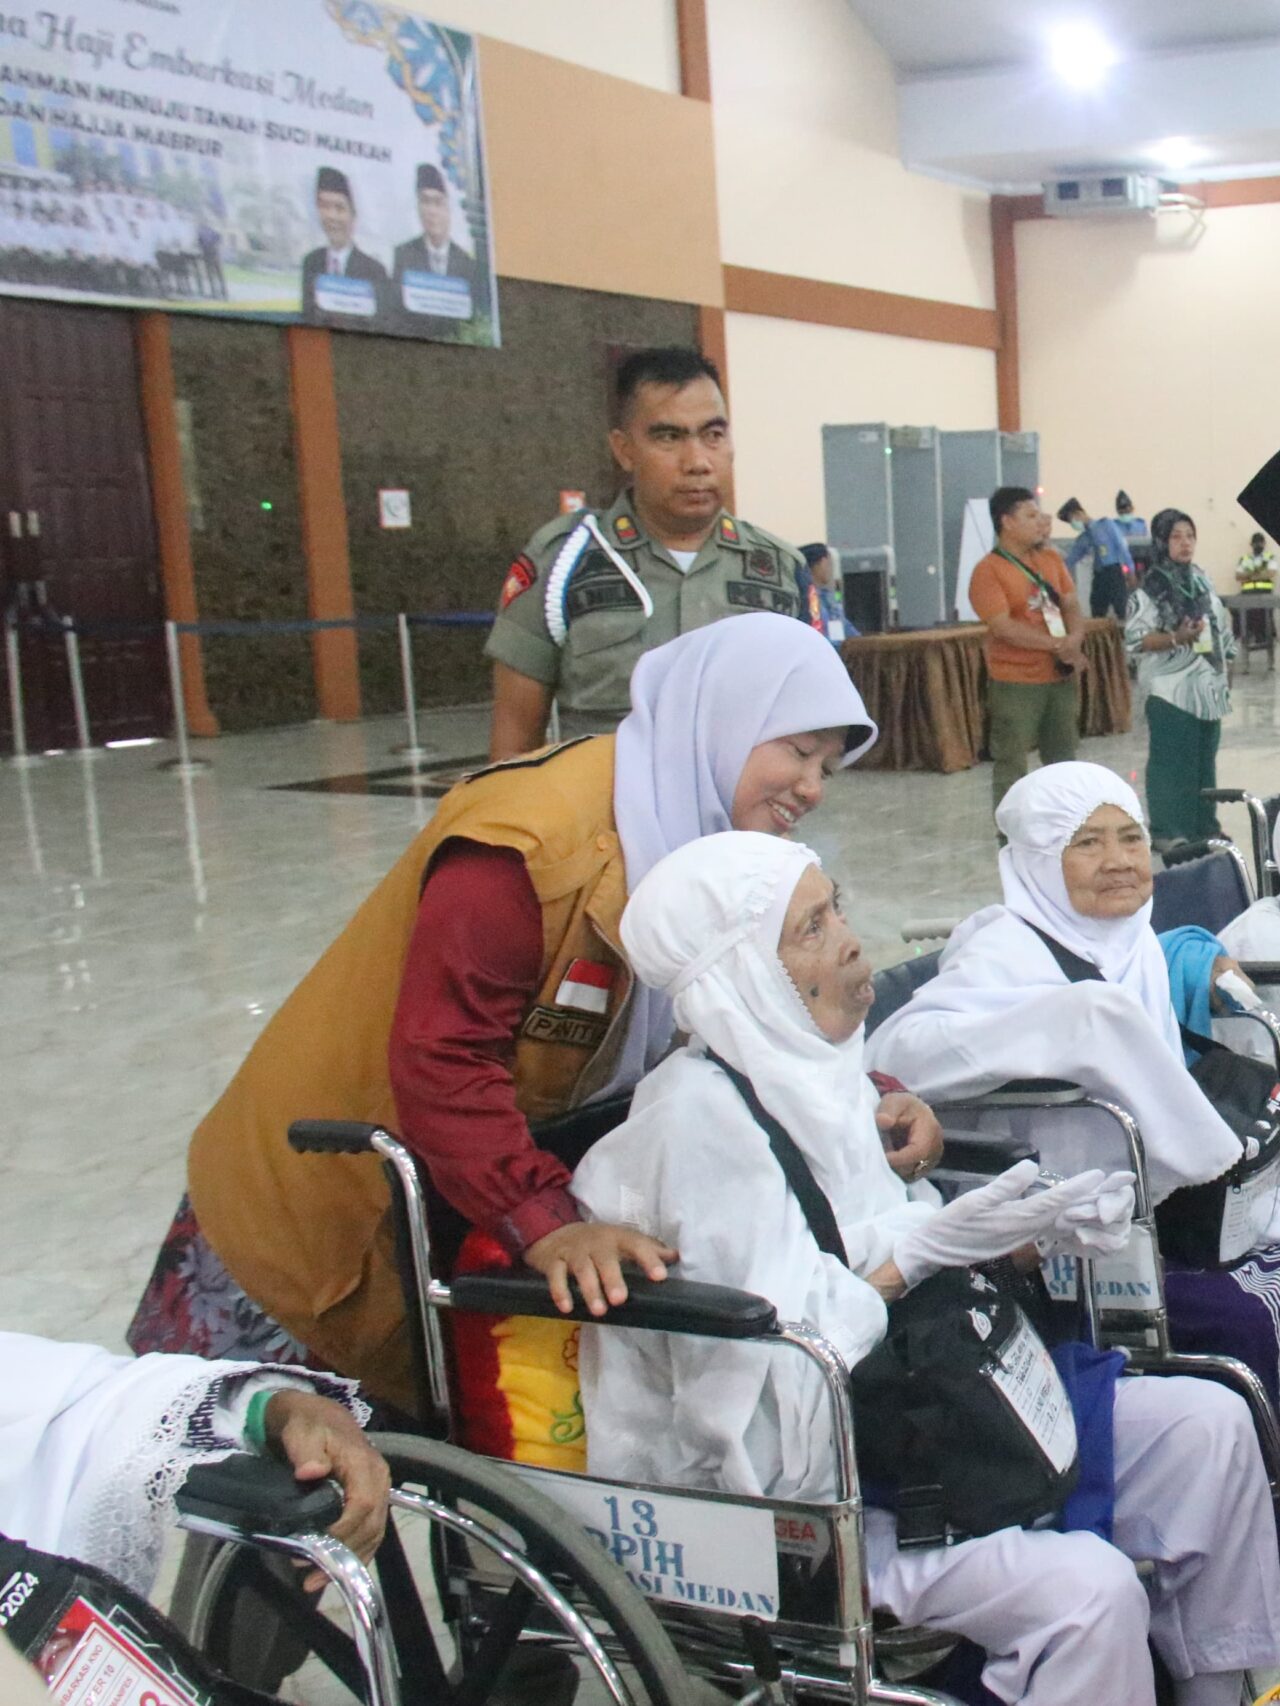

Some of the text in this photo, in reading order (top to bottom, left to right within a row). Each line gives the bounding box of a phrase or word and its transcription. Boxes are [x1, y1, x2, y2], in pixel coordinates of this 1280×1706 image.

[36, 11, 114, 69] Haji
[123, 31, 275, 95] Embarkasi
[279, 69, 374, 119] Medan
[97, 84, 190, 122] MENUJU
[1096, 1281, 1152, 1297] EDAN
[604, 1495, 658, 1538] 13
[0, 1572, 40, 1618] 2024
[673, 1580, 775, 1615] MEDAN
